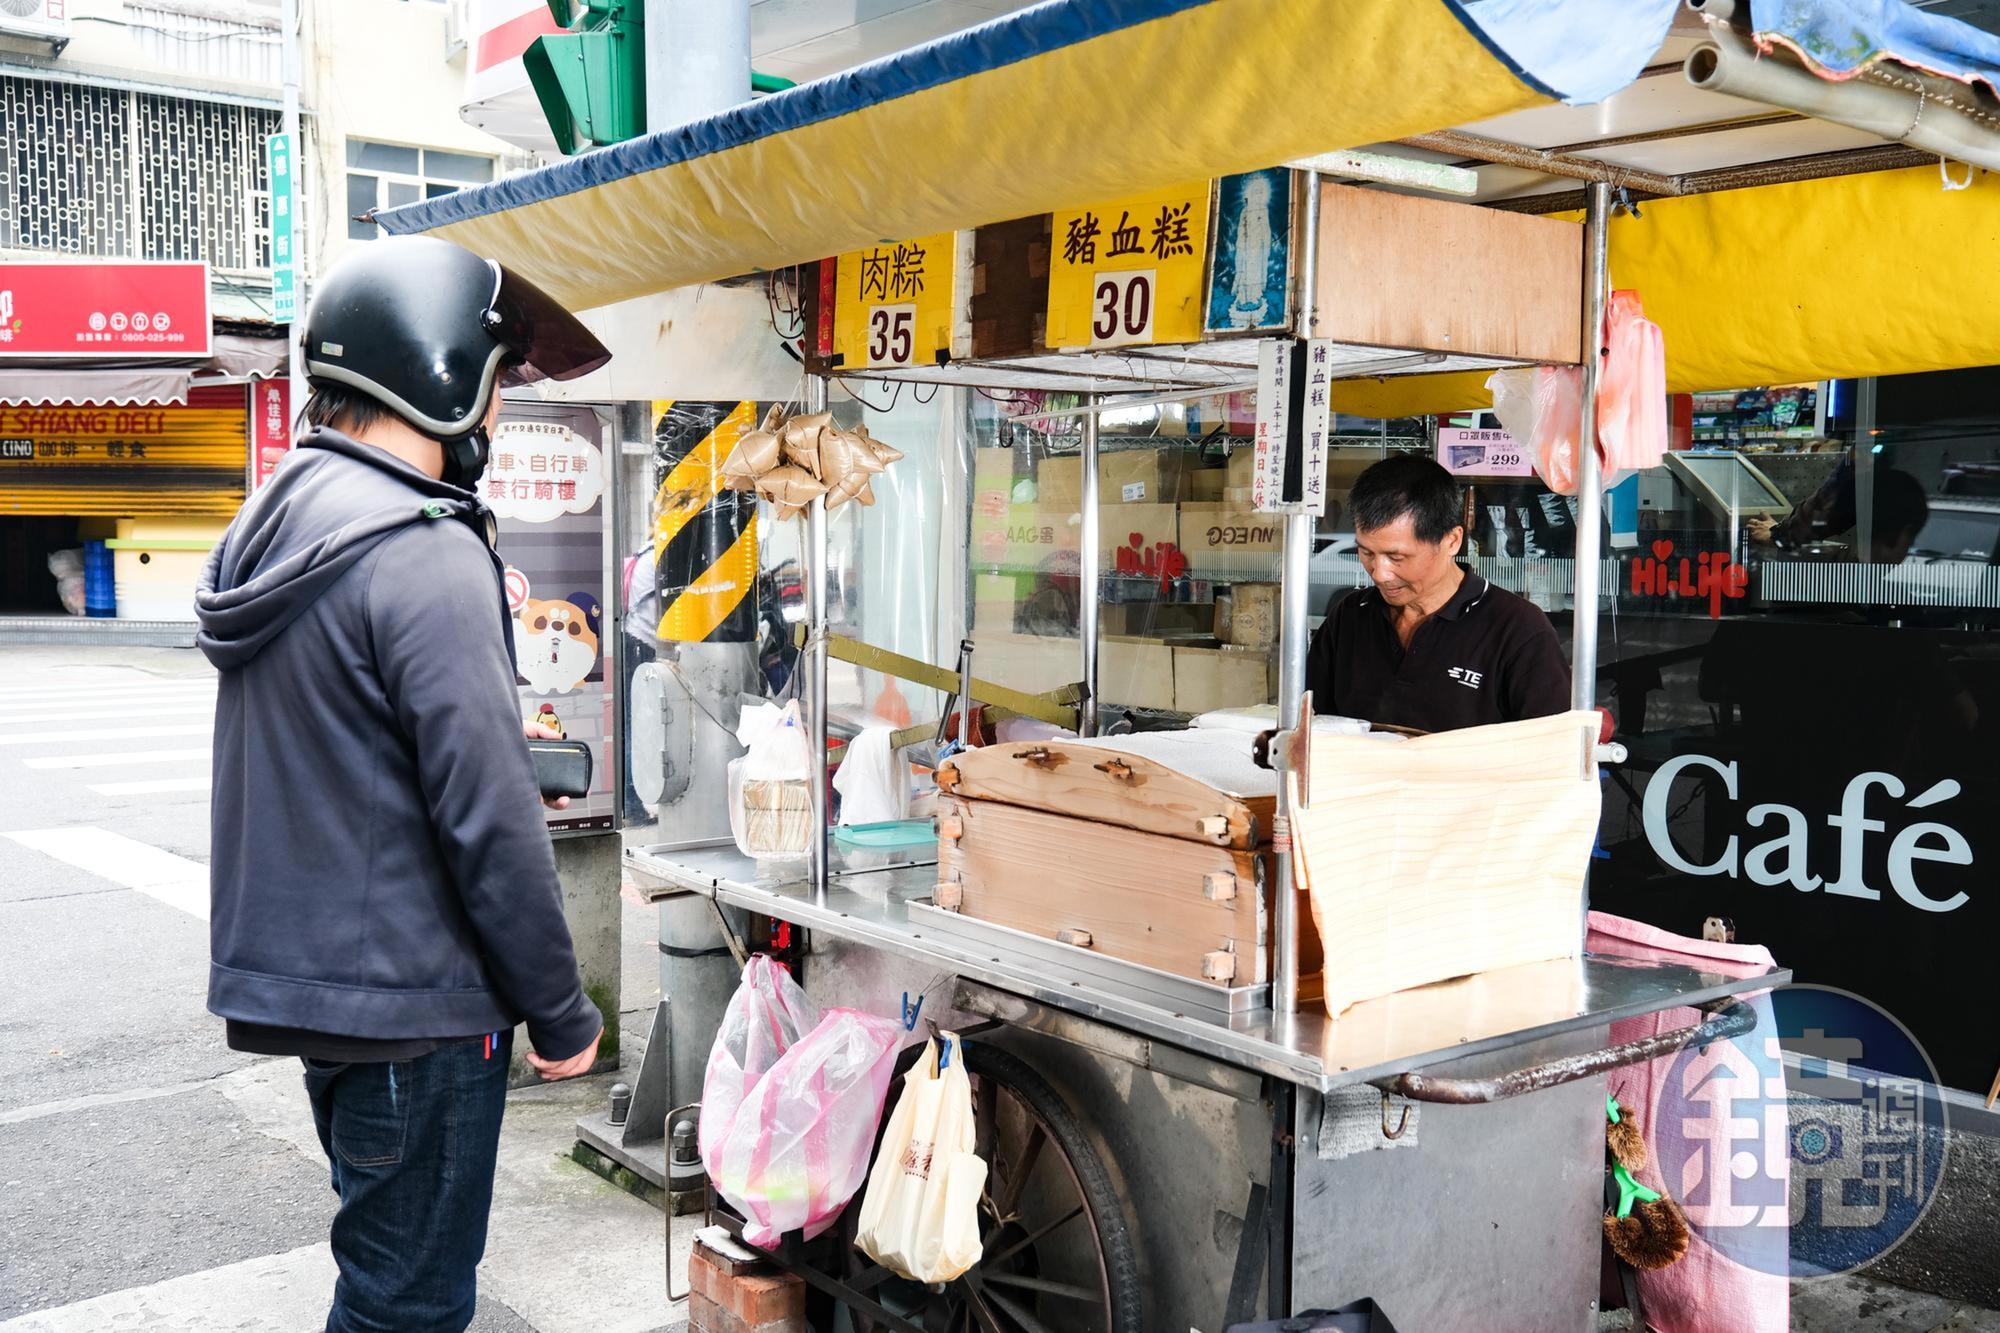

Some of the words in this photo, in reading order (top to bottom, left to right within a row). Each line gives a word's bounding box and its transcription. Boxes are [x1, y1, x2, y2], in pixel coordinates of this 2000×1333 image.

[1063, 202, 1193, 264] 豬血糕
[860, 242, 926, 302] 肉粽
[870, 310, 912, 363] 35
[1093, 276, 1150, 340] 30
[11, 411, 109, 434] SHIANG
[115, 411, 166, 434] DELI
[488, 479, 576, 501] 禁行騎樓
[1254, 422, 1268, 509] 星期日公休
[1491, 454, 1520, 466] 299
[1643, 754, 1974, 913] Café
